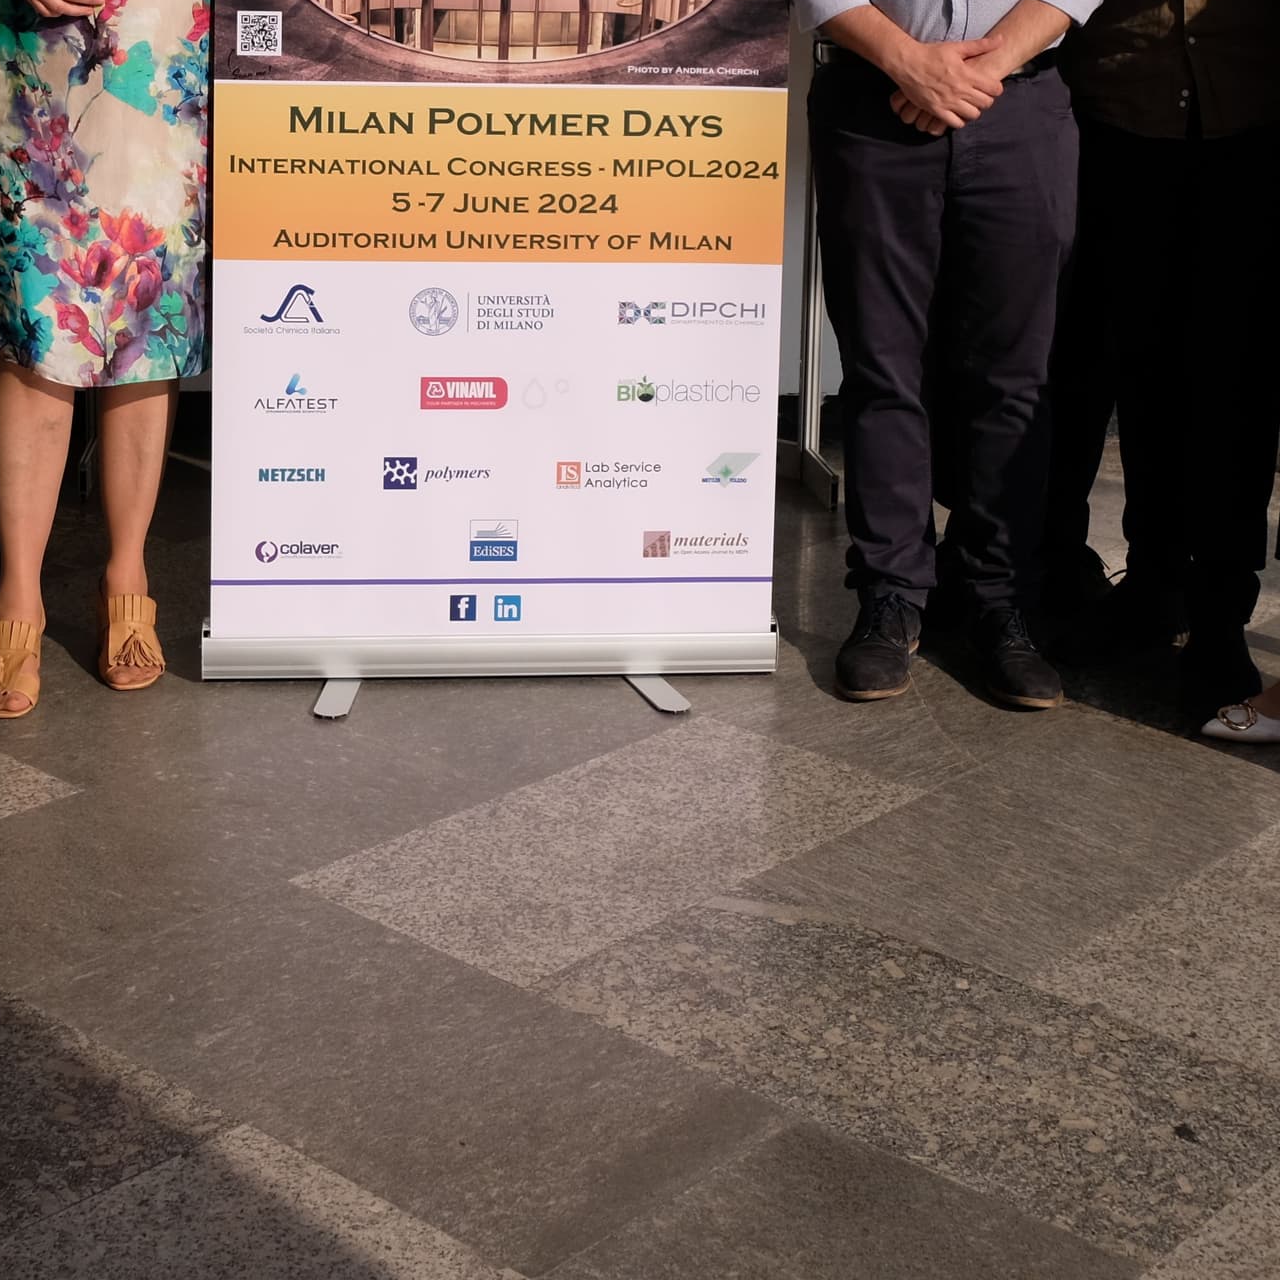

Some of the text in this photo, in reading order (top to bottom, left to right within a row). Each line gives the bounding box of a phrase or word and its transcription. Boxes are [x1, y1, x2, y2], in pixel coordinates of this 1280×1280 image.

[627, 65, 660, 74] PHOTO
[675, 66, 714, 75] ANDREA
[716, 66, 759, 76] CHERCHI
[289, 106, 723, 138] MILAN POLYMER DAYS
[229, 155, 440, 176] INTERNATIONAL
[447, 157, 592, 177] CONGRESS
[612, 159, 780, 180] MIPOL2024
[453, 193, 529, 213] JUNE
[537, 194, 619, 214] 2024
[273, 229, 733, 251] AUDITORIUM UNIVERSITY OF MILAN
[477, 294, 551, 306] UNIVERSITÀ
[477, 308, 555, 318] DEGLI STUDI
[671, 302, 766, 319] DIPCHI
[243, 326, 341, 335] Società Chimica Italiana
[477, 320, 544, 330] DI MILANO
[446, 381, 497, 398] VINAVIL
[254, 398, 339, 410] ALFATEST
[424, 466, 491, 483] polymers
[584, 462, 662, 473] Lab Service
[258, 468, 326, 482] NETZSCH
[584, 477, 648, 490] Analytica
[673, 532, 749, 548] materials
[280, 540, 340, 555] colaver
[473, 545, 515, 557] EdiSES
